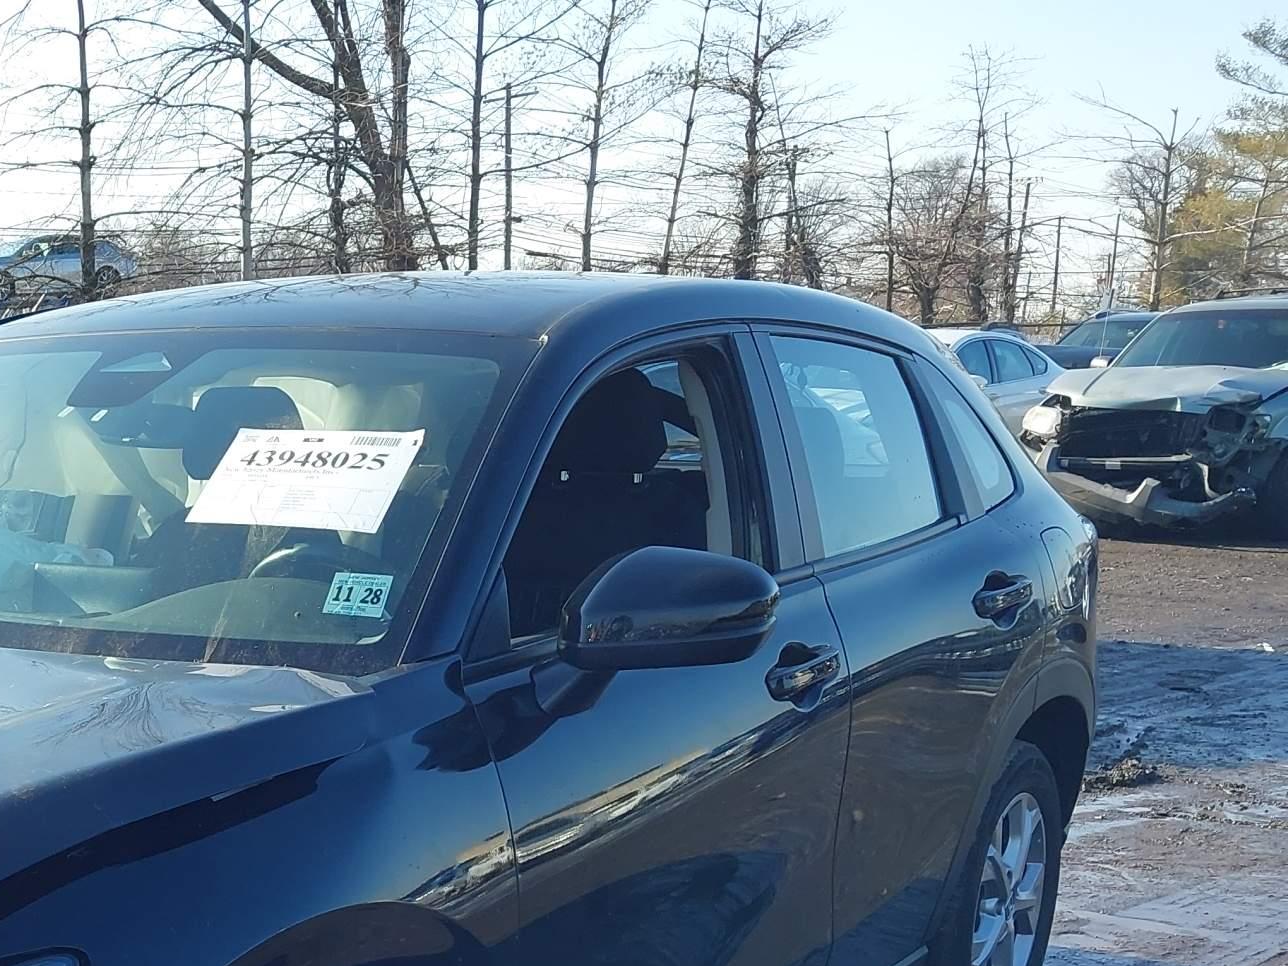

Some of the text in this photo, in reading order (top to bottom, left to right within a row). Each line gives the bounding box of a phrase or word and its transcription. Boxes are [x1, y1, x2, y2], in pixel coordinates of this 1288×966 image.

[240, 450, 389, 470] 43948025
[332, 585, 383, 605] 11 28
